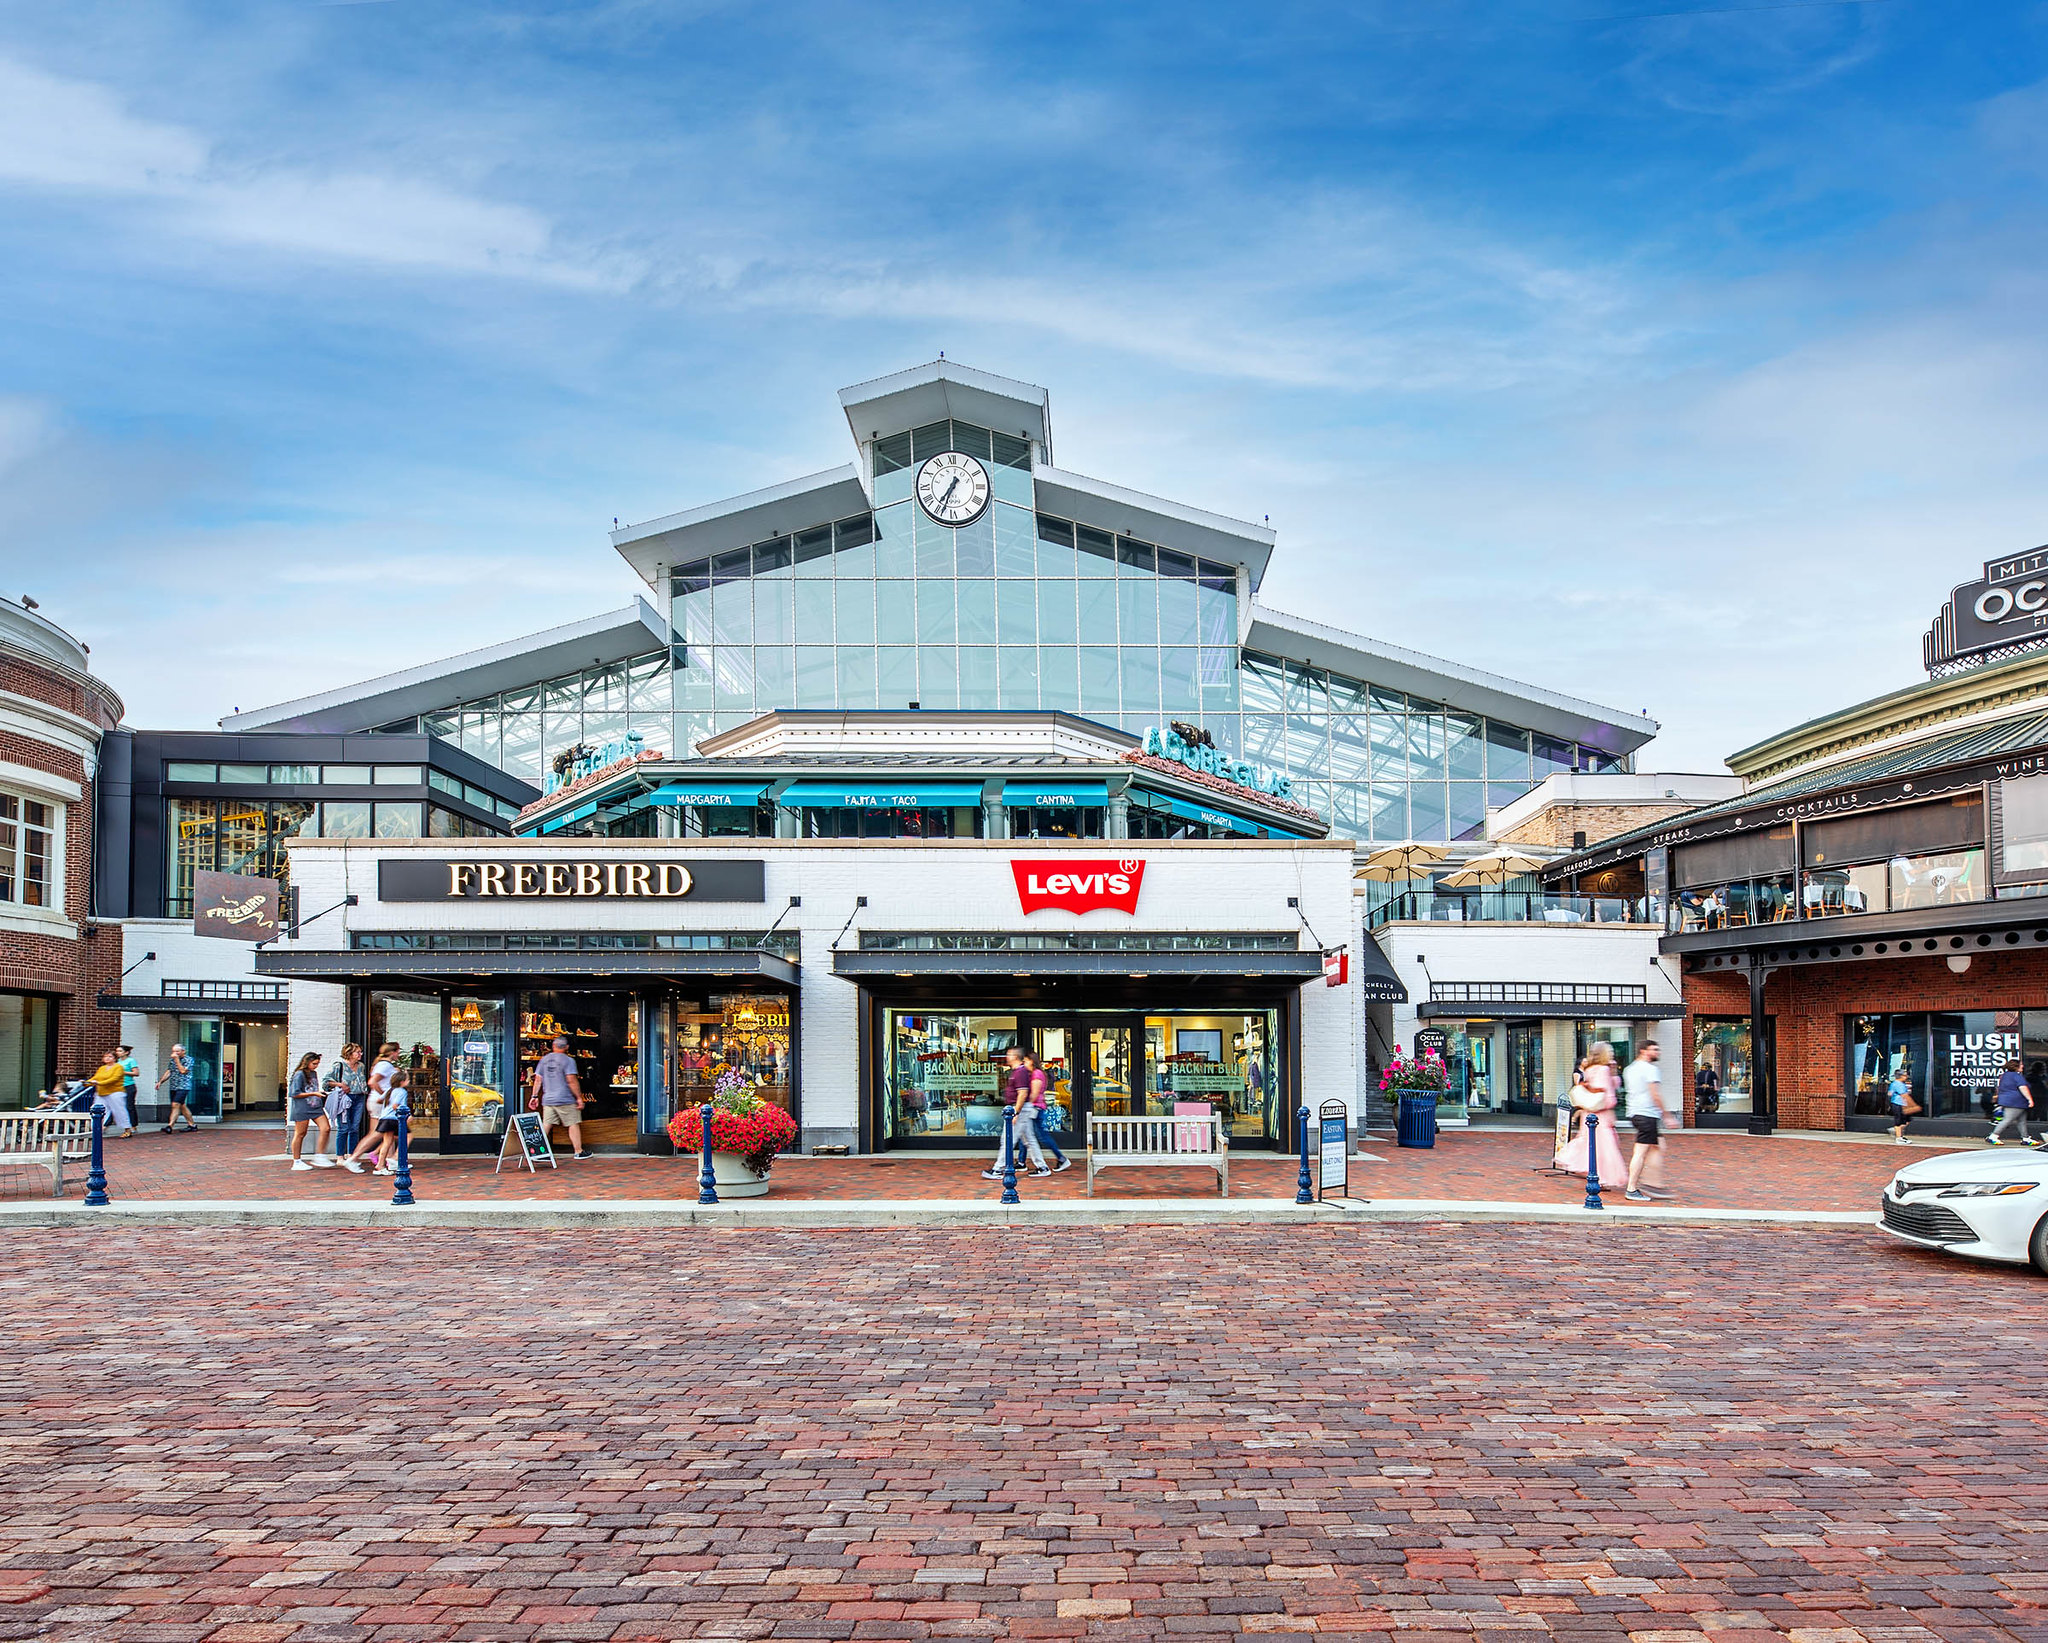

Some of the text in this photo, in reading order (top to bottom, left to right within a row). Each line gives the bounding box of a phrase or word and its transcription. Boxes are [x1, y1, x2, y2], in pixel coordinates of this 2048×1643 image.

[2000, 556, 2048, 578] MIT
[1974, 580, 2048, 622] OC
[2034, 616, 2048, 628] FI
[1996, 758, 2045, 774] WINE
[676, 794, 732, 804] MARGARITA
[844, 796, 917, 806] FAJITA TACO
[1036, 796, 1075, 805] CANTINA
[1776, 794, 1858, 817] COCKTAILS
[1201, 812, 1232, 828] MARGARITA
[1653, 828, 1690, 844] STEAKS
[1564, 858, 1592, 873] SEAFOOD
[447, 862, 693, 896] FREEBIRD
[206, 895, 266, 918] FREEBIRD
[1366, 982, 1394, 990] CHELL'S
[1950, 1032, 2020, 1050] LUSH
[1950, 1052, 2020, 1066] FRESH
[924, 1062, 998, 1074] BACK IN BLUE
[1172, 1062, 1245, 1074] BACK IN BLUE
[1950, 1068, 2008, 1076] HANDMA
[1950, 1078, 2000, 1087] COSMET
